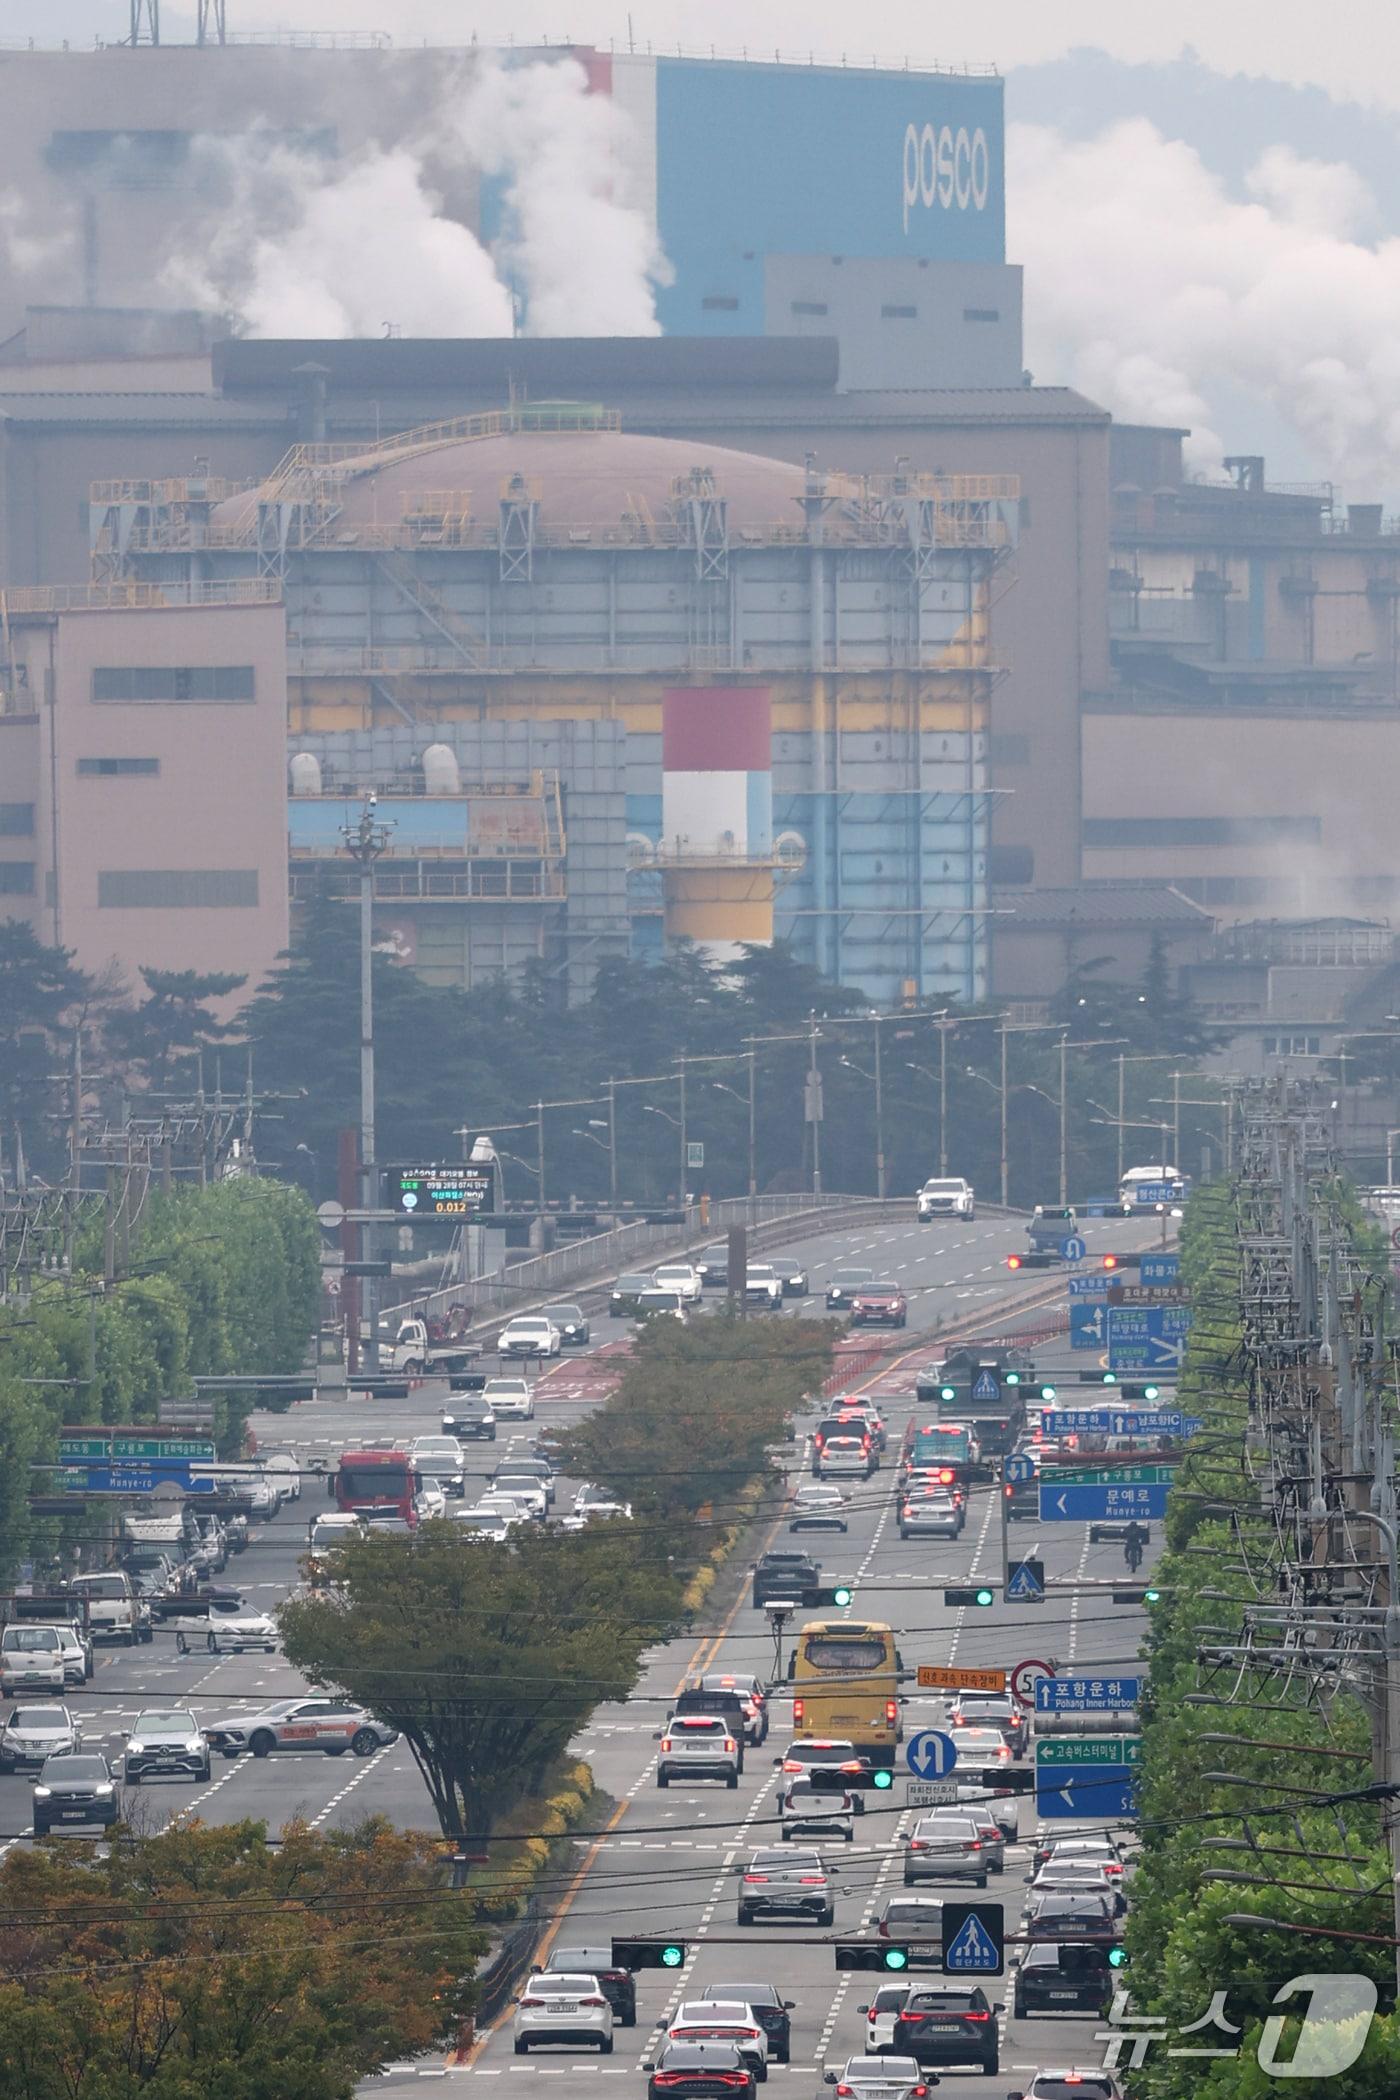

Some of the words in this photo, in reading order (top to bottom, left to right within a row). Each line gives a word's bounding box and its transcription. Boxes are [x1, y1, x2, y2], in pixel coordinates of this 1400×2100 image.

[435, 1202, 466, 1212] 0.012
[1106, 1489, 1150, 1504] 문예로
[1055, 1682, 1121, 1697] 포항운하
[1056, 1699, 1085, 1709] Pohang
[1086, 1699, 1106, 1708] Inner
[1056, 1745, 1117, 1759] 고속버스터미널
